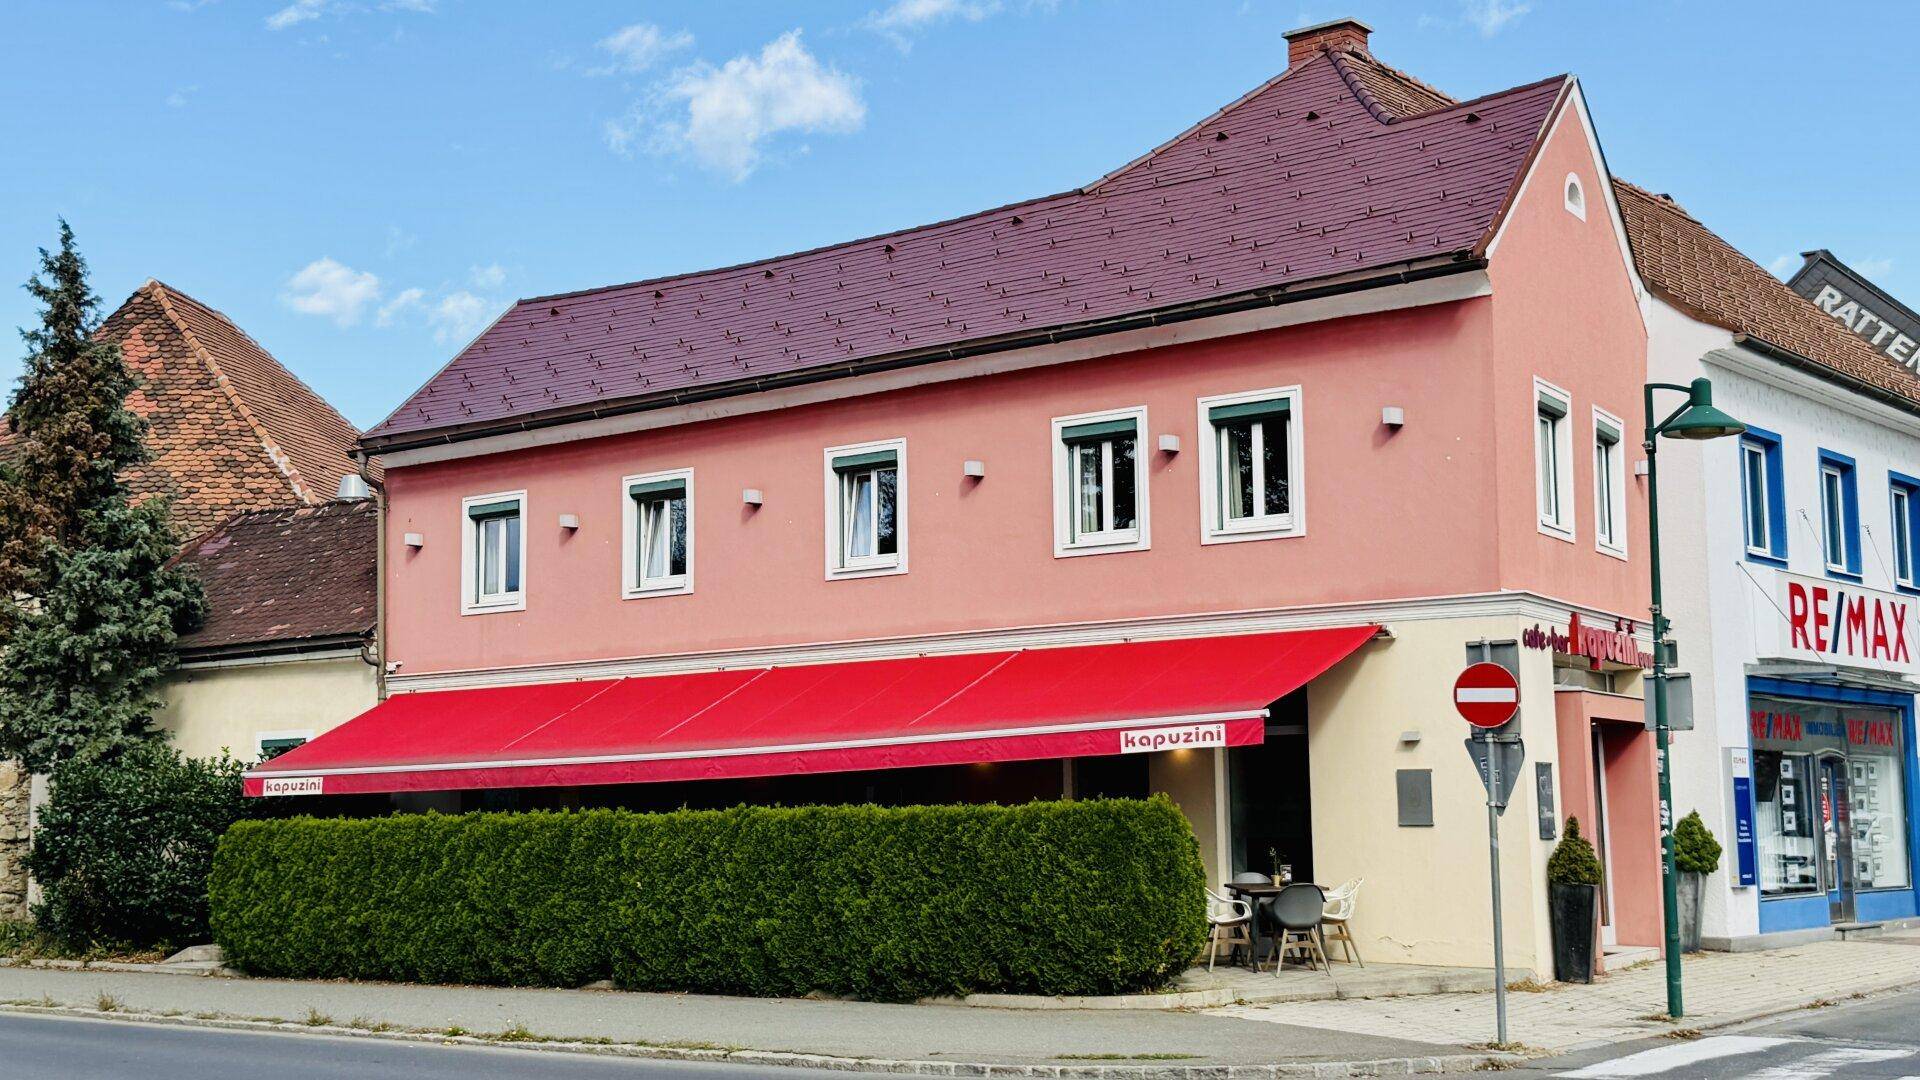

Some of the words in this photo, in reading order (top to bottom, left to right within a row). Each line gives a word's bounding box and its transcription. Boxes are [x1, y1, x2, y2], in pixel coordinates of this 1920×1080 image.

[1788, 581, 1910, 663] RE/MAX
[1569, 612, 1638, 671] kapuzini
[1124, 725, 1222, 750] kapuzini
[1750, 710, 1803, 742] RE/MAX
[1847, 719, 1894, 746] RE/MAX
[266, 778, 321, 794] kapuzini
